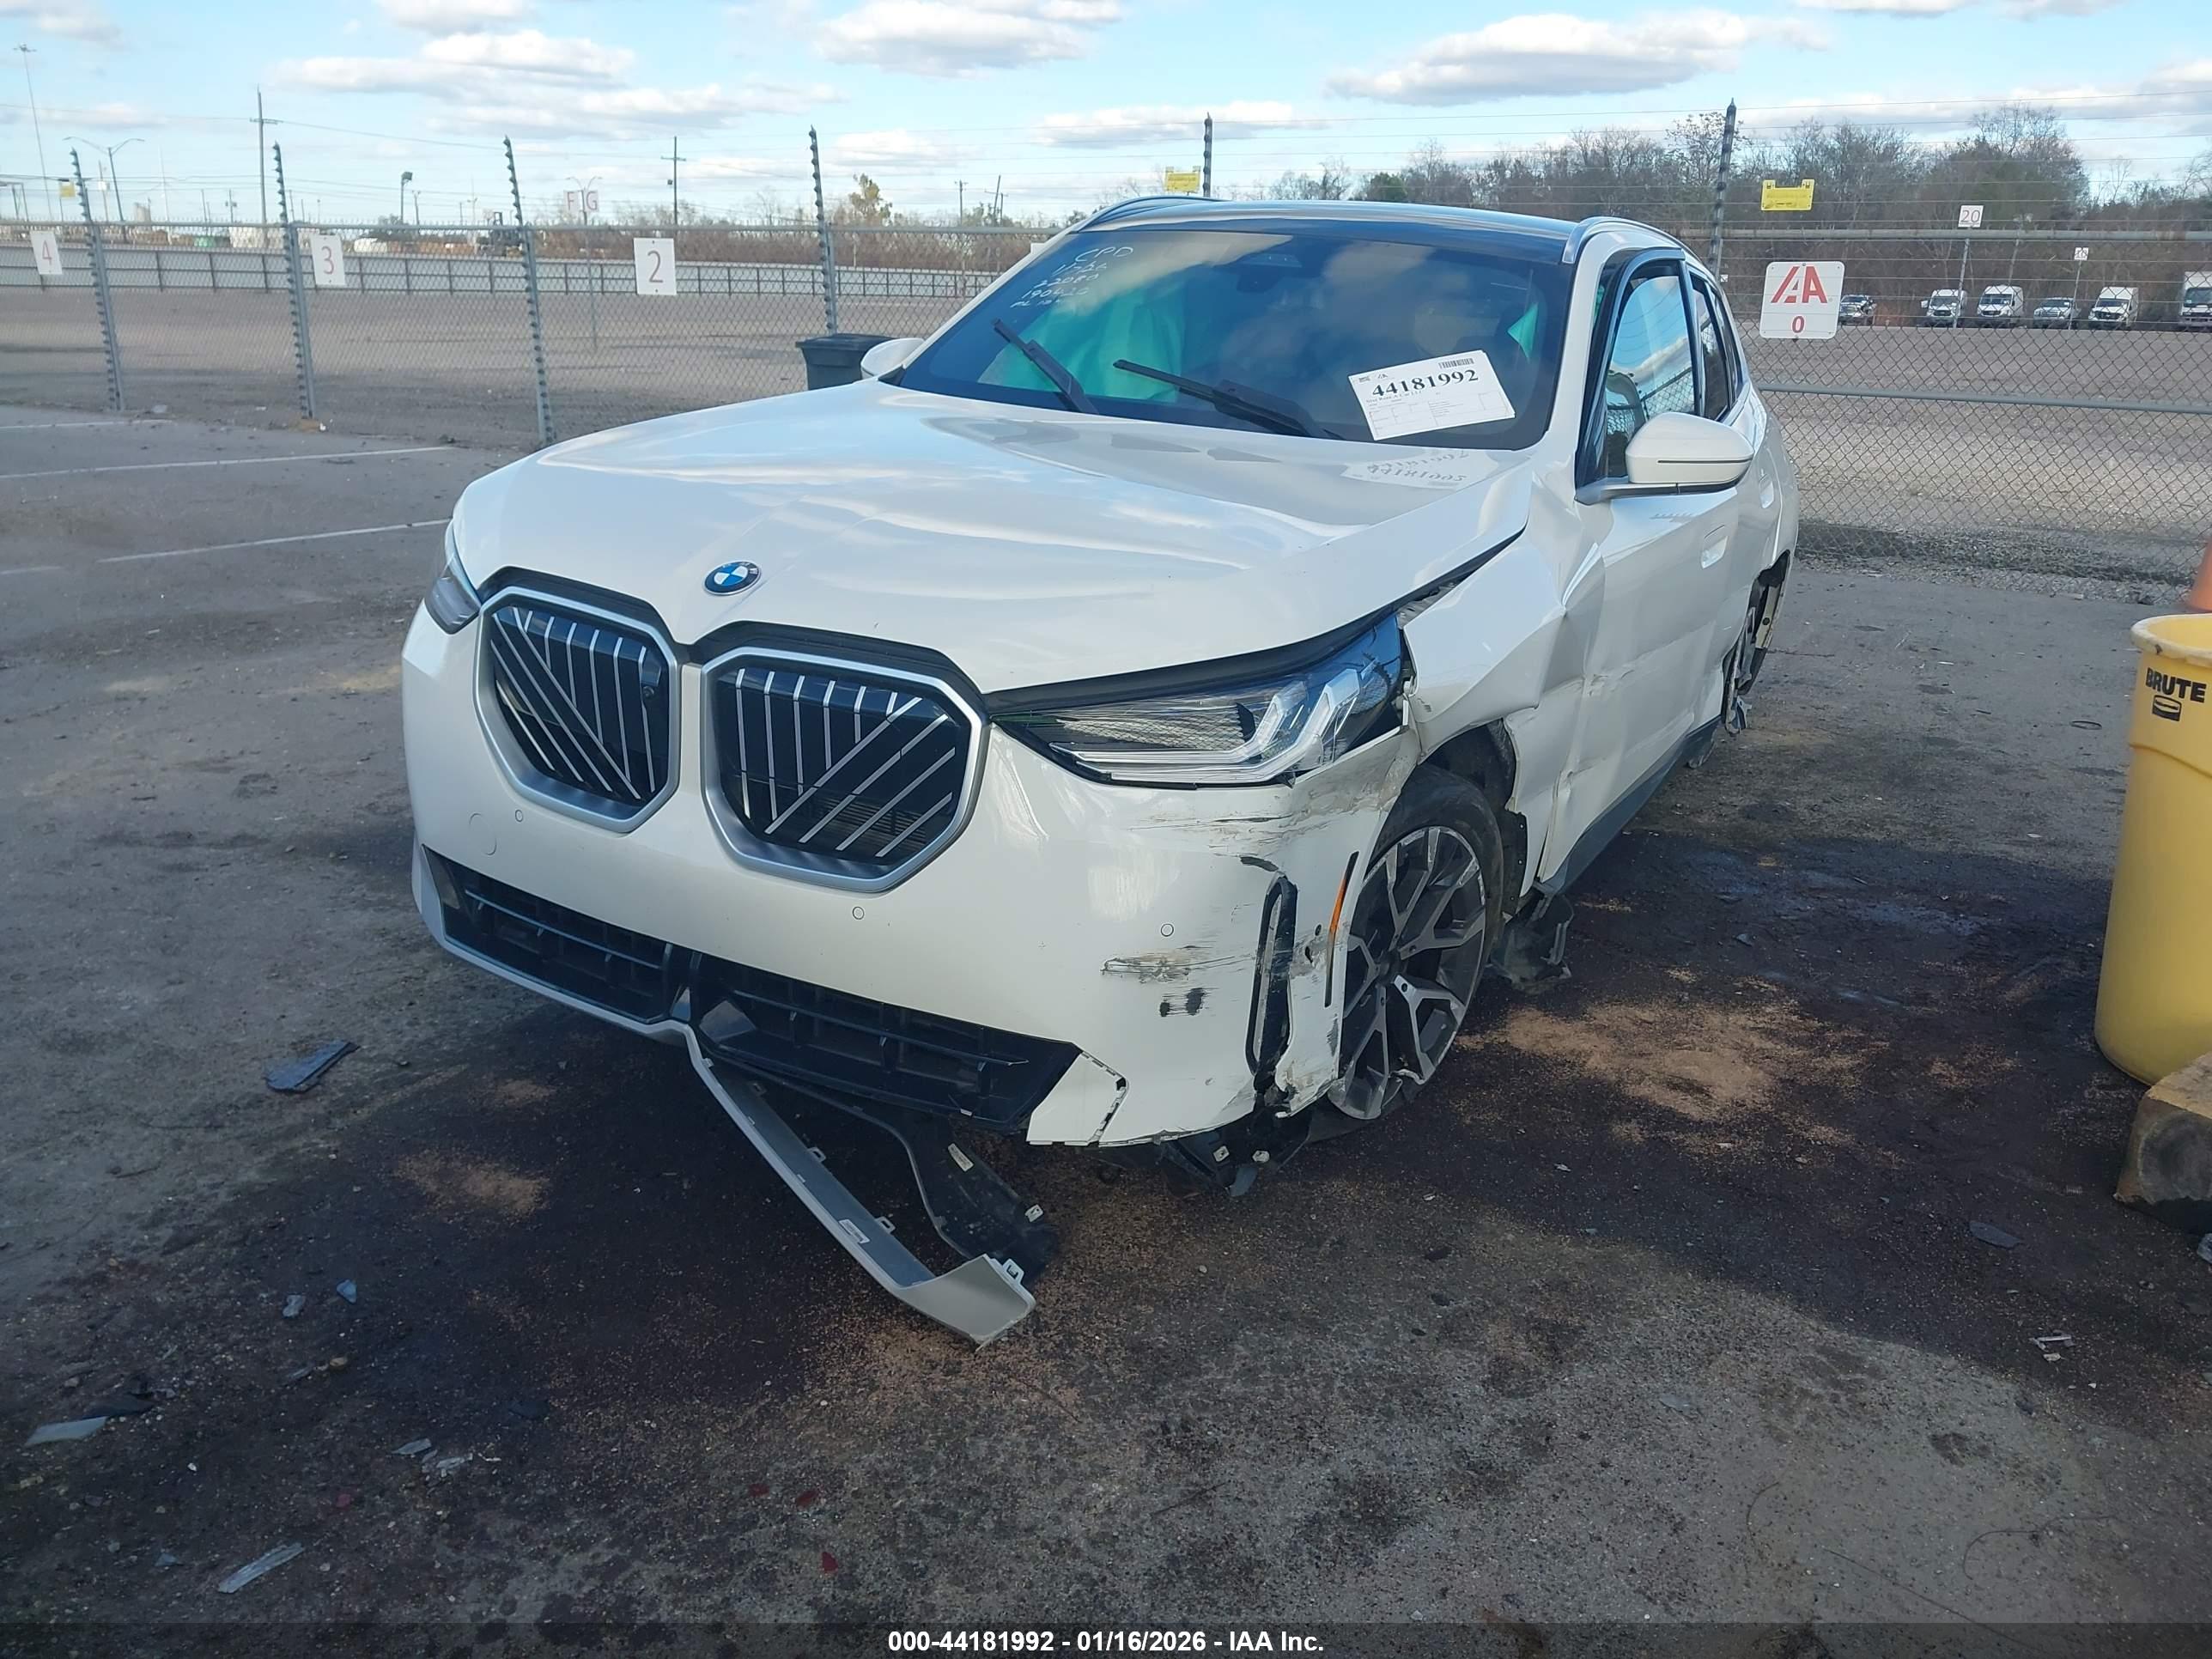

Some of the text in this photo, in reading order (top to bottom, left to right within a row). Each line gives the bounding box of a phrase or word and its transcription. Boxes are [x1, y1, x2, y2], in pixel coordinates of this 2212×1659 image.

[1961, 210, 1981, 223] 20
[41, 240, 52, 266] 4
[321, 246, 334, 275] 3
[647, 250, 664, 283] 2
[1075, 246, 1133, 262] CPD
[1372, 369, 1479, 397] 44181992
[2145, 666, 2207, 703] BRUTE
